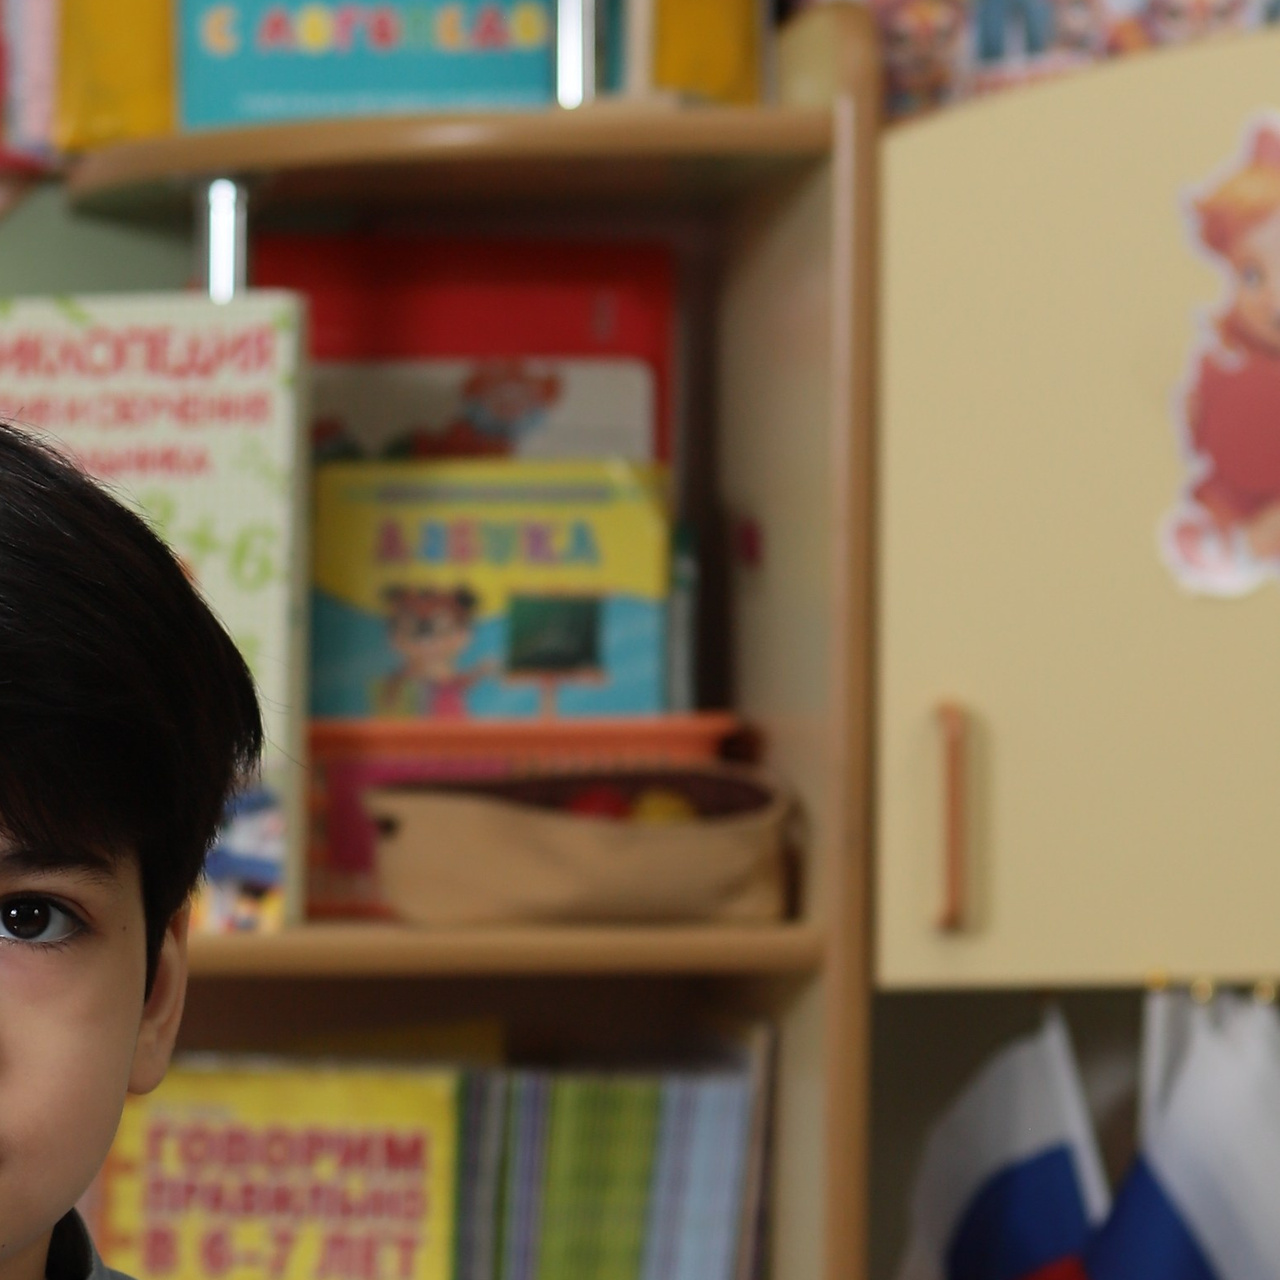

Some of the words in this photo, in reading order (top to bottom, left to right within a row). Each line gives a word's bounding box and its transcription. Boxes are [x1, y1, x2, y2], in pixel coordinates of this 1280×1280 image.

[376, 517, 603, 567] АЗБУКА
[147, 1121, 427, 1174] ГОВОРИМ
[145, 1175, 427, 1222] ПРАВИЛЬНО
